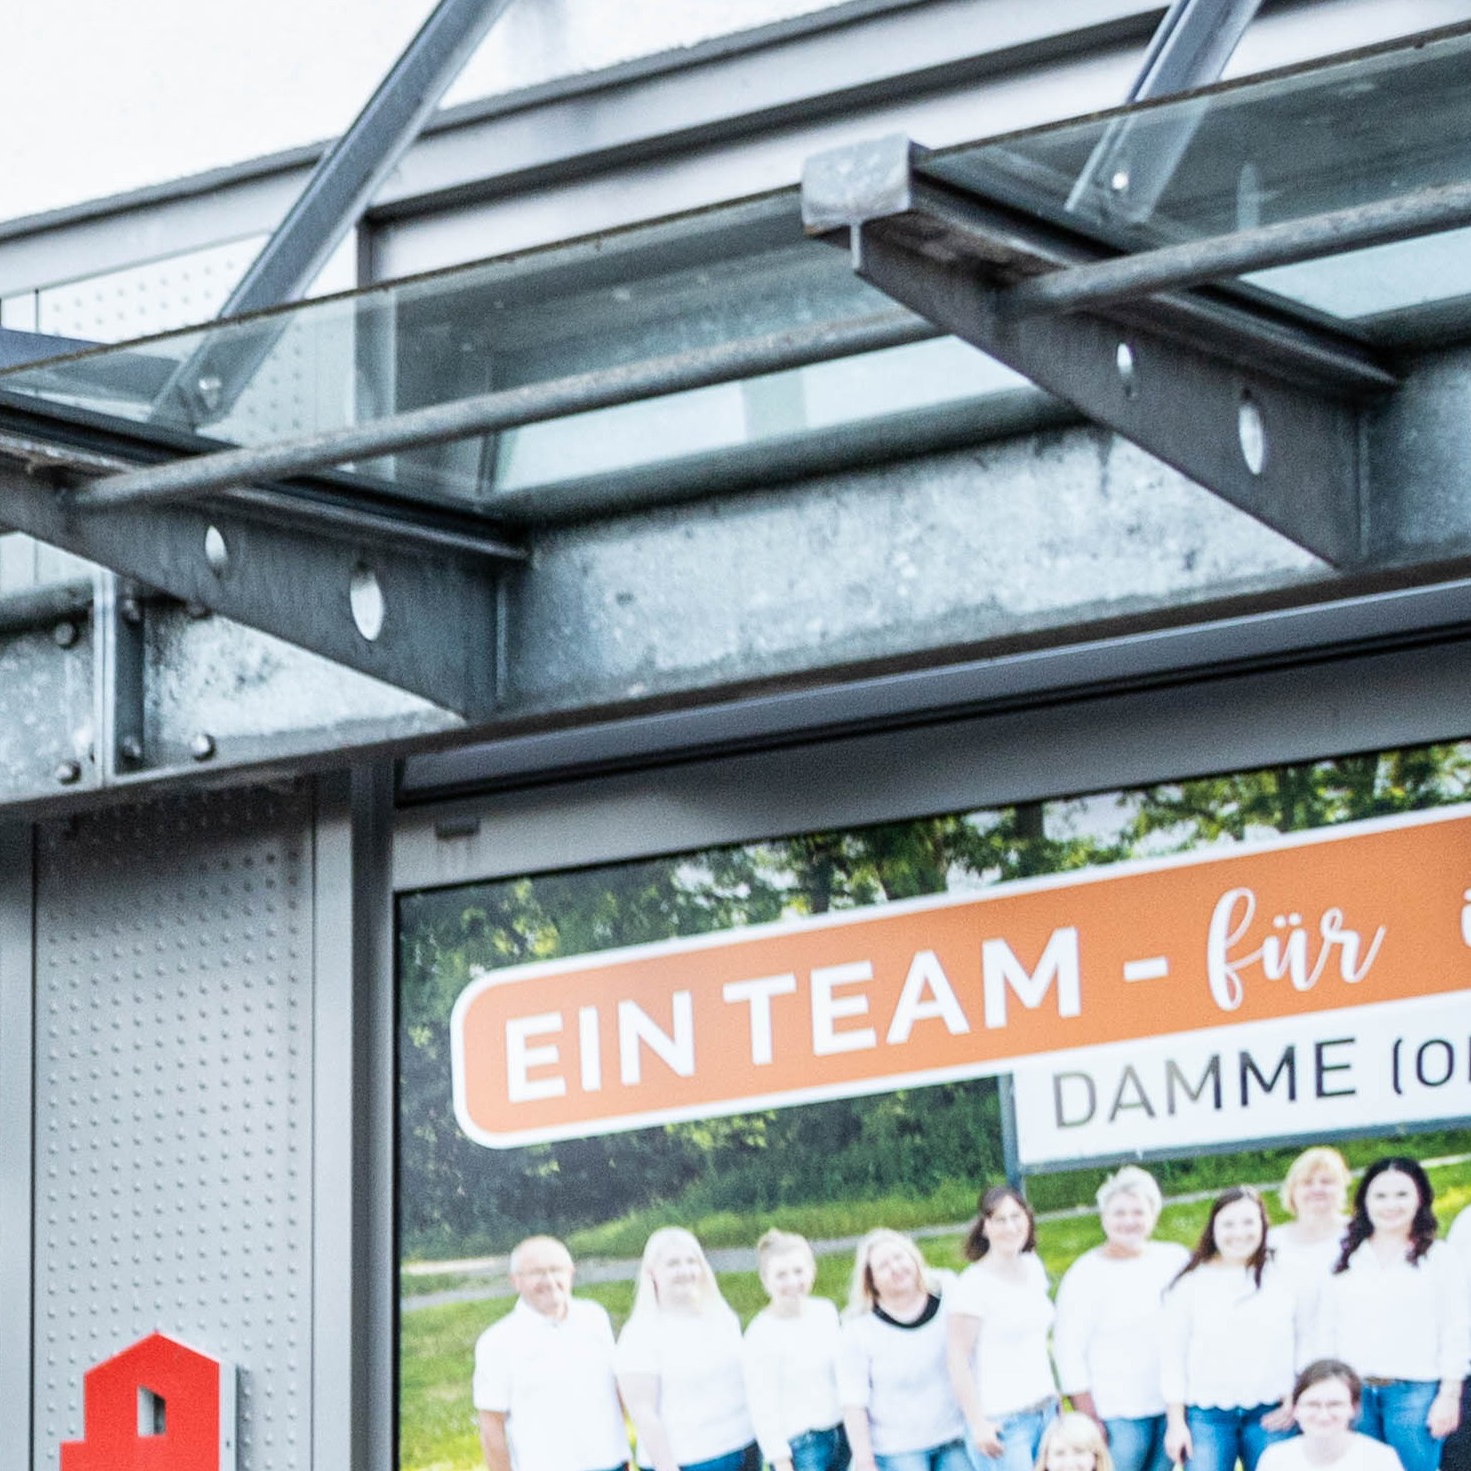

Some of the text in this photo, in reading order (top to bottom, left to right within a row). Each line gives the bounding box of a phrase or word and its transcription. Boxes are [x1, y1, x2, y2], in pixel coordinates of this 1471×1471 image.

[504, 990, 697, 1105] EIN
[721, 926, 1082, 1067] TEAM
[1207, 887, 1387, 1012] für
[1051, 1036, 1471, 1129] DAMME (O
